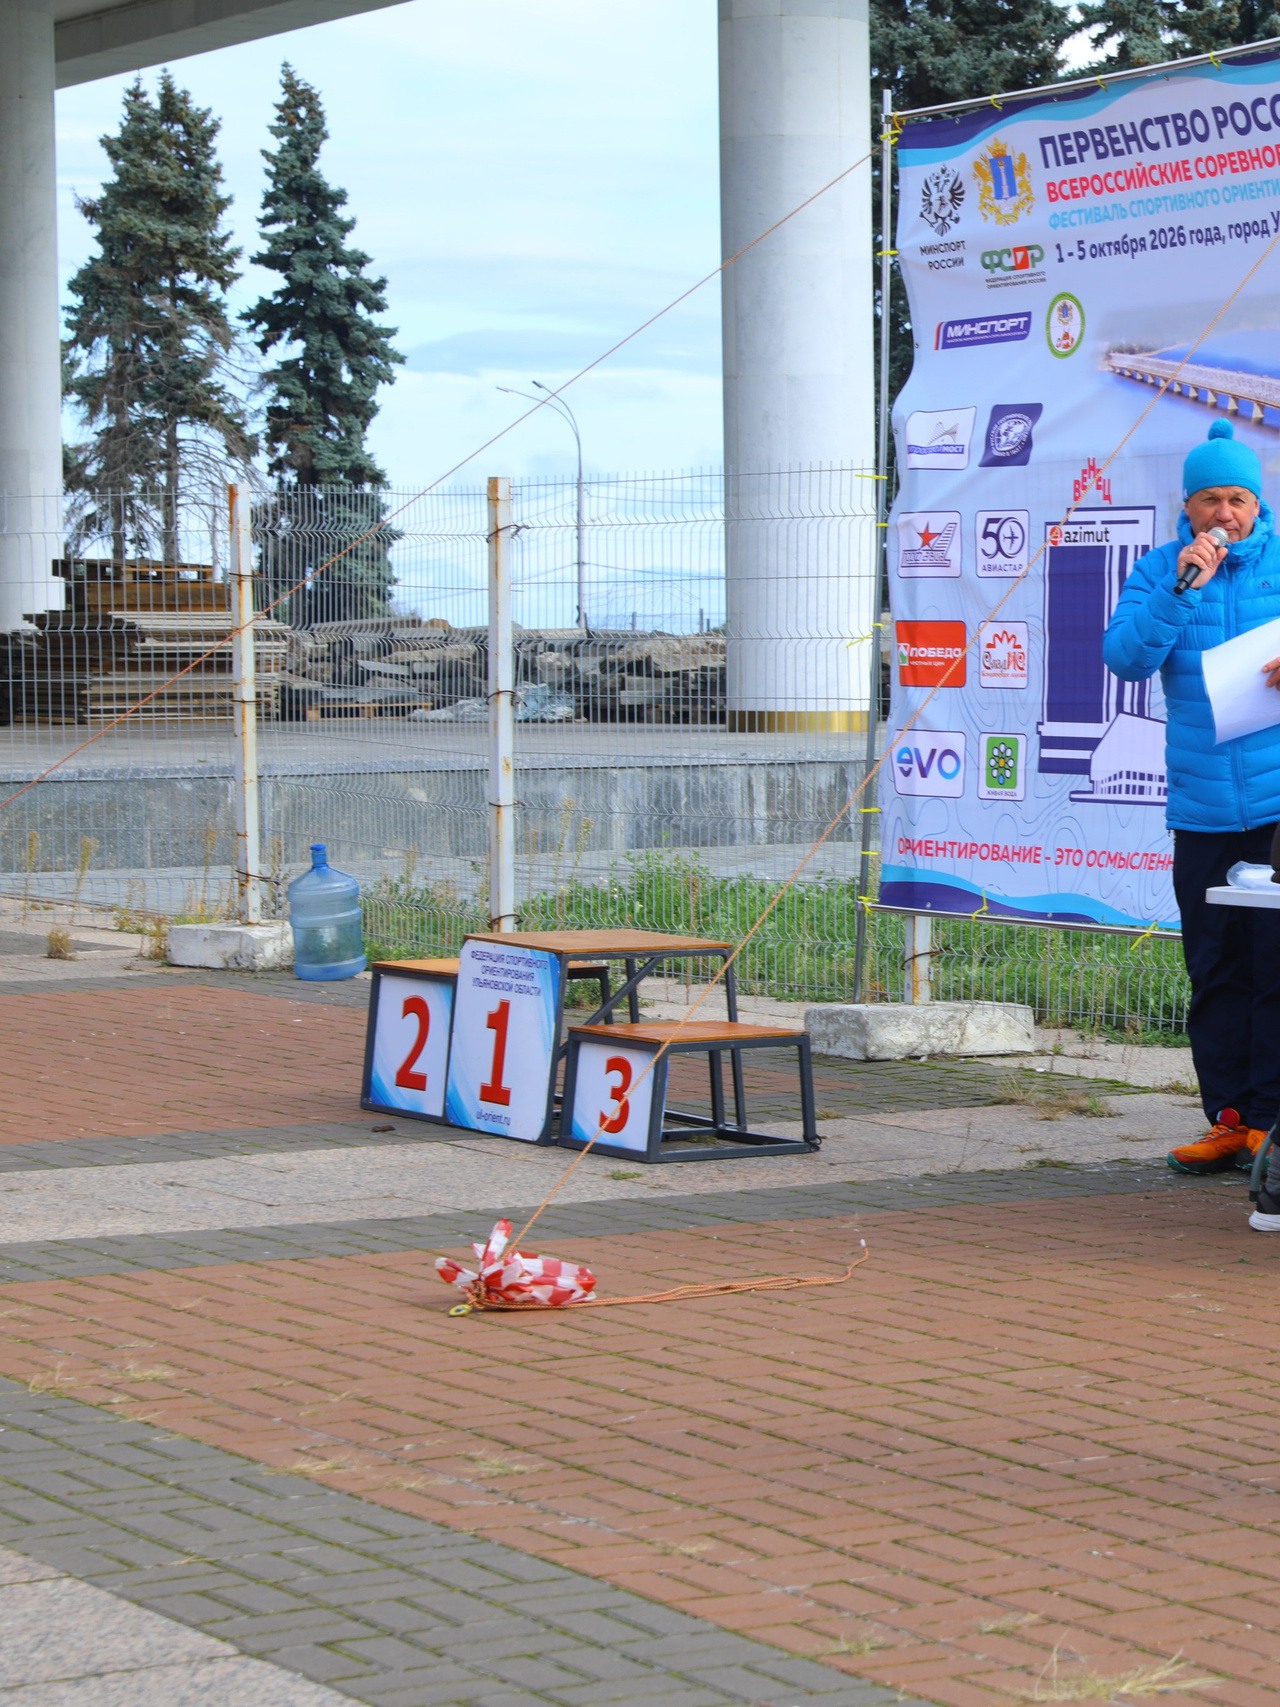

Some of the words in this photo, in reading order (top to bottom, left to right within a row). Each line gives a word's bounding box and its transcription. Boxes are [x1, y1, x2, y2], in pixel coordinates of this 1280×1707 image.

[1039, 108, 1210, 169] ПЕРВЕНСТВО
[1046, 159, 1194, 203] ВСЕРОССИЙСКИЕ
[1048, 203, 1128, 230] ФЕСТИВАЛЬ
[1129, 187, 1221, 218] СПОРТИВНОГО
[919, 240, 966, 256] МИНСПОРТ
[1055, 243, 1065, 263] 1
[1076, 239, 1086, 261] 5
[1089, 233, 1147, 259] октября
[1149, 225, 1187, 251] 2026
[1188, 225, 1226, 246] года,
[1227, 219, 1271, 244] город
[927, 256, 965, 271] РОССИИ
[946, 316, 1029, 338] МИНСПОРТ
[1073, 457, 1112, 505] ВЕНЕЦ
[981, 517, 1025, 559] 50
[1064, 526, 1110, 543] azimut
[982, 563, 1023, 573] АВИАСТАР
[897, 746, 962, 780] evo
[897, 837, 1043, 865] ОРИЕНТИРОВАНИЕ
[1054, 848, 1084, 868] ЭТО
[1085, 850, 1174, 872] ОСМЫСЛЕНН
[470, 950, 505, 964] ФЕДЕРАЦИЯ
[506, 955, 549, 970] СПОРТИВНОГО
[480, 965, 535, 982] ОРИЕНТИРОВАНИЯ
[472, 977, 514, 992] УЛЬЯНОВСКОЙ
[514, 983, 542, 997] ОБЛАСТИ
[395, 995, 431, 1092] 2
[479, 999, 512, 1106] 1
[599, 1055, 633, 1134] 3
